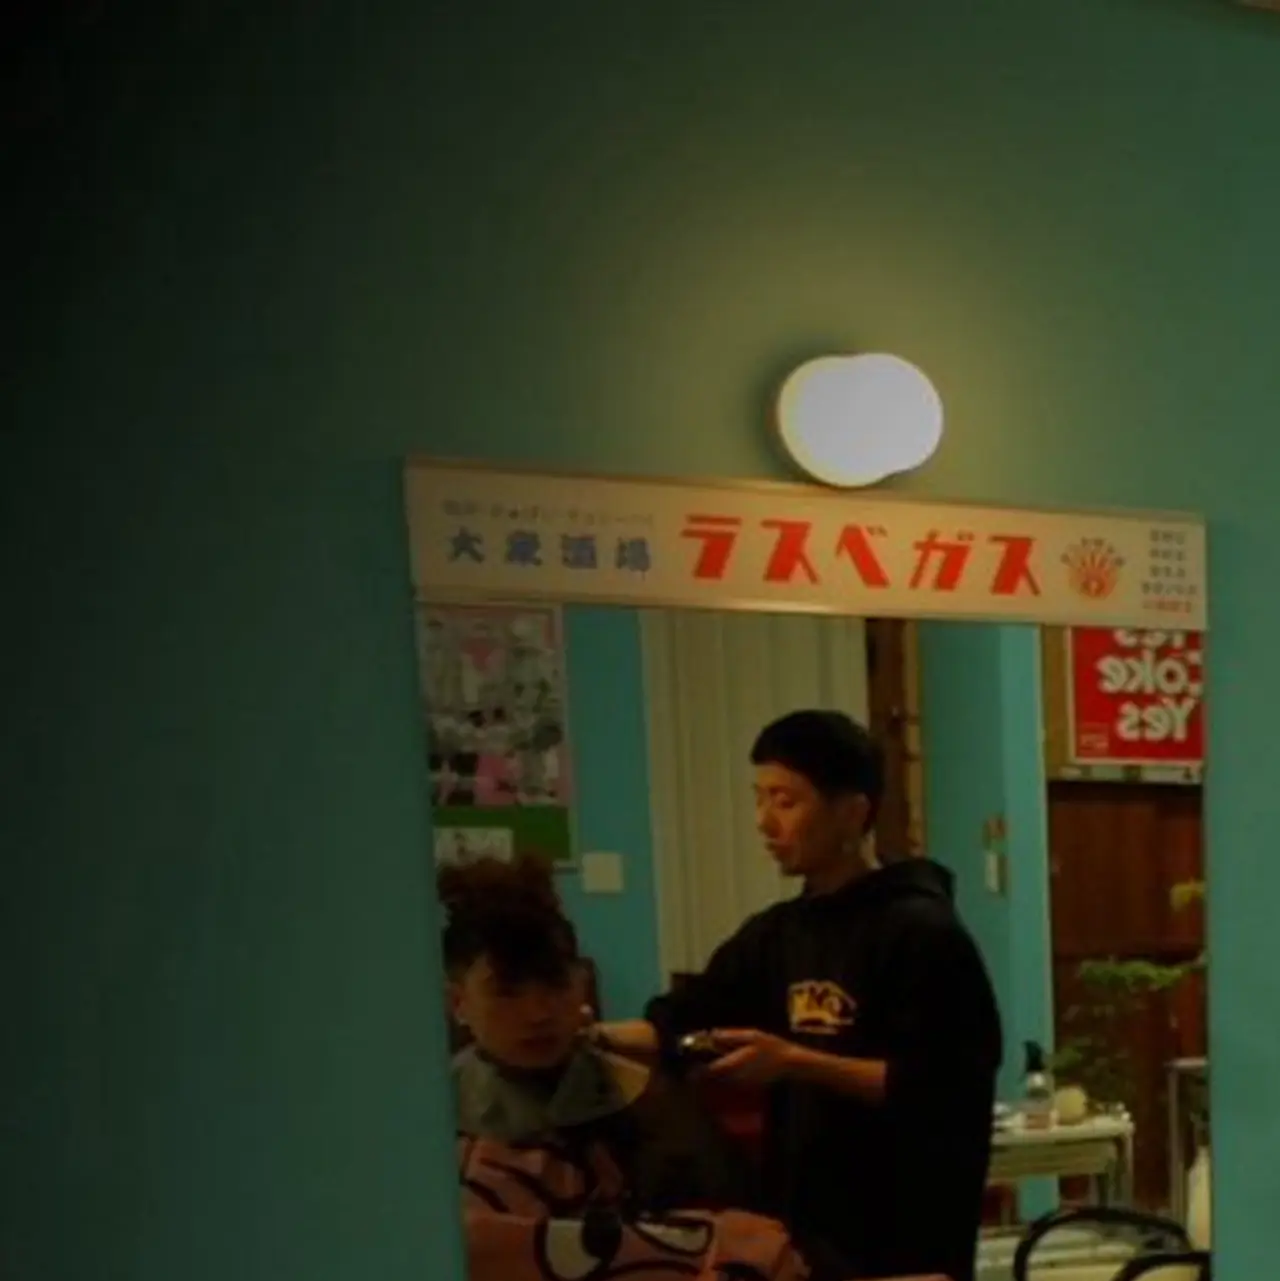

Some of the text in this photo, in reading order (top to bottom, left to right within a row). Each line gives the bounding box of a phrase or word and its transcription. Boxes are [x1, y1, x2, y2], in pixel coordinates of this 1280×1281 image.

[680, 514, 1040, 597] ラスベガス
